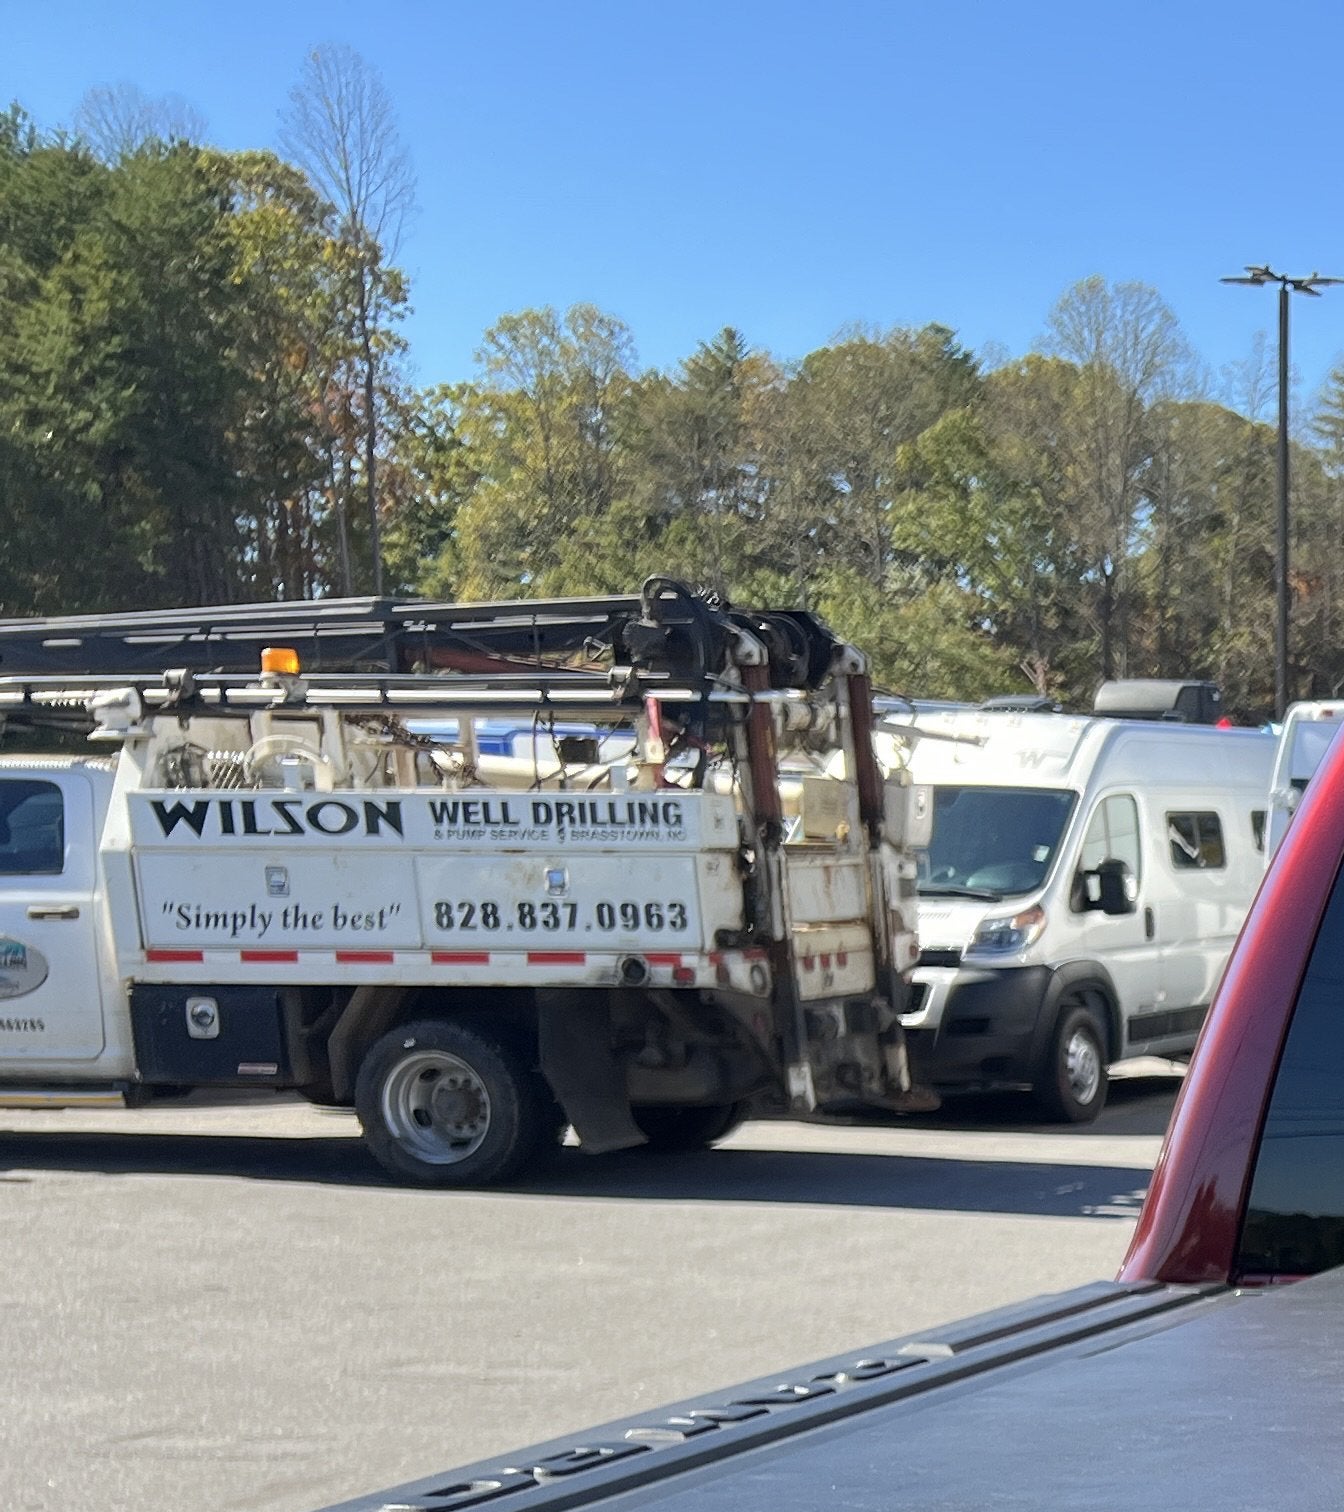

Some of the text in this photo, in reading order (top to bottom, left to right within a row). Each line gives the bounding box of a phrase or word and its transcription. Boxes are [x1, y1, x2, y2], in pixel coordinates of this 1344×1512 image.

[150, 800, 405, 839] WILSON
[428, 801, 683, 827] WELL DRILLING
[433, 829, 443, 841] &
[447, 829, 484, 841] PUMP
[490, 829, 549, 841] SERVICE
[162, 902, 401, 938] "Simply the best"
[434, 902, 689, 931] 828.837.0963
